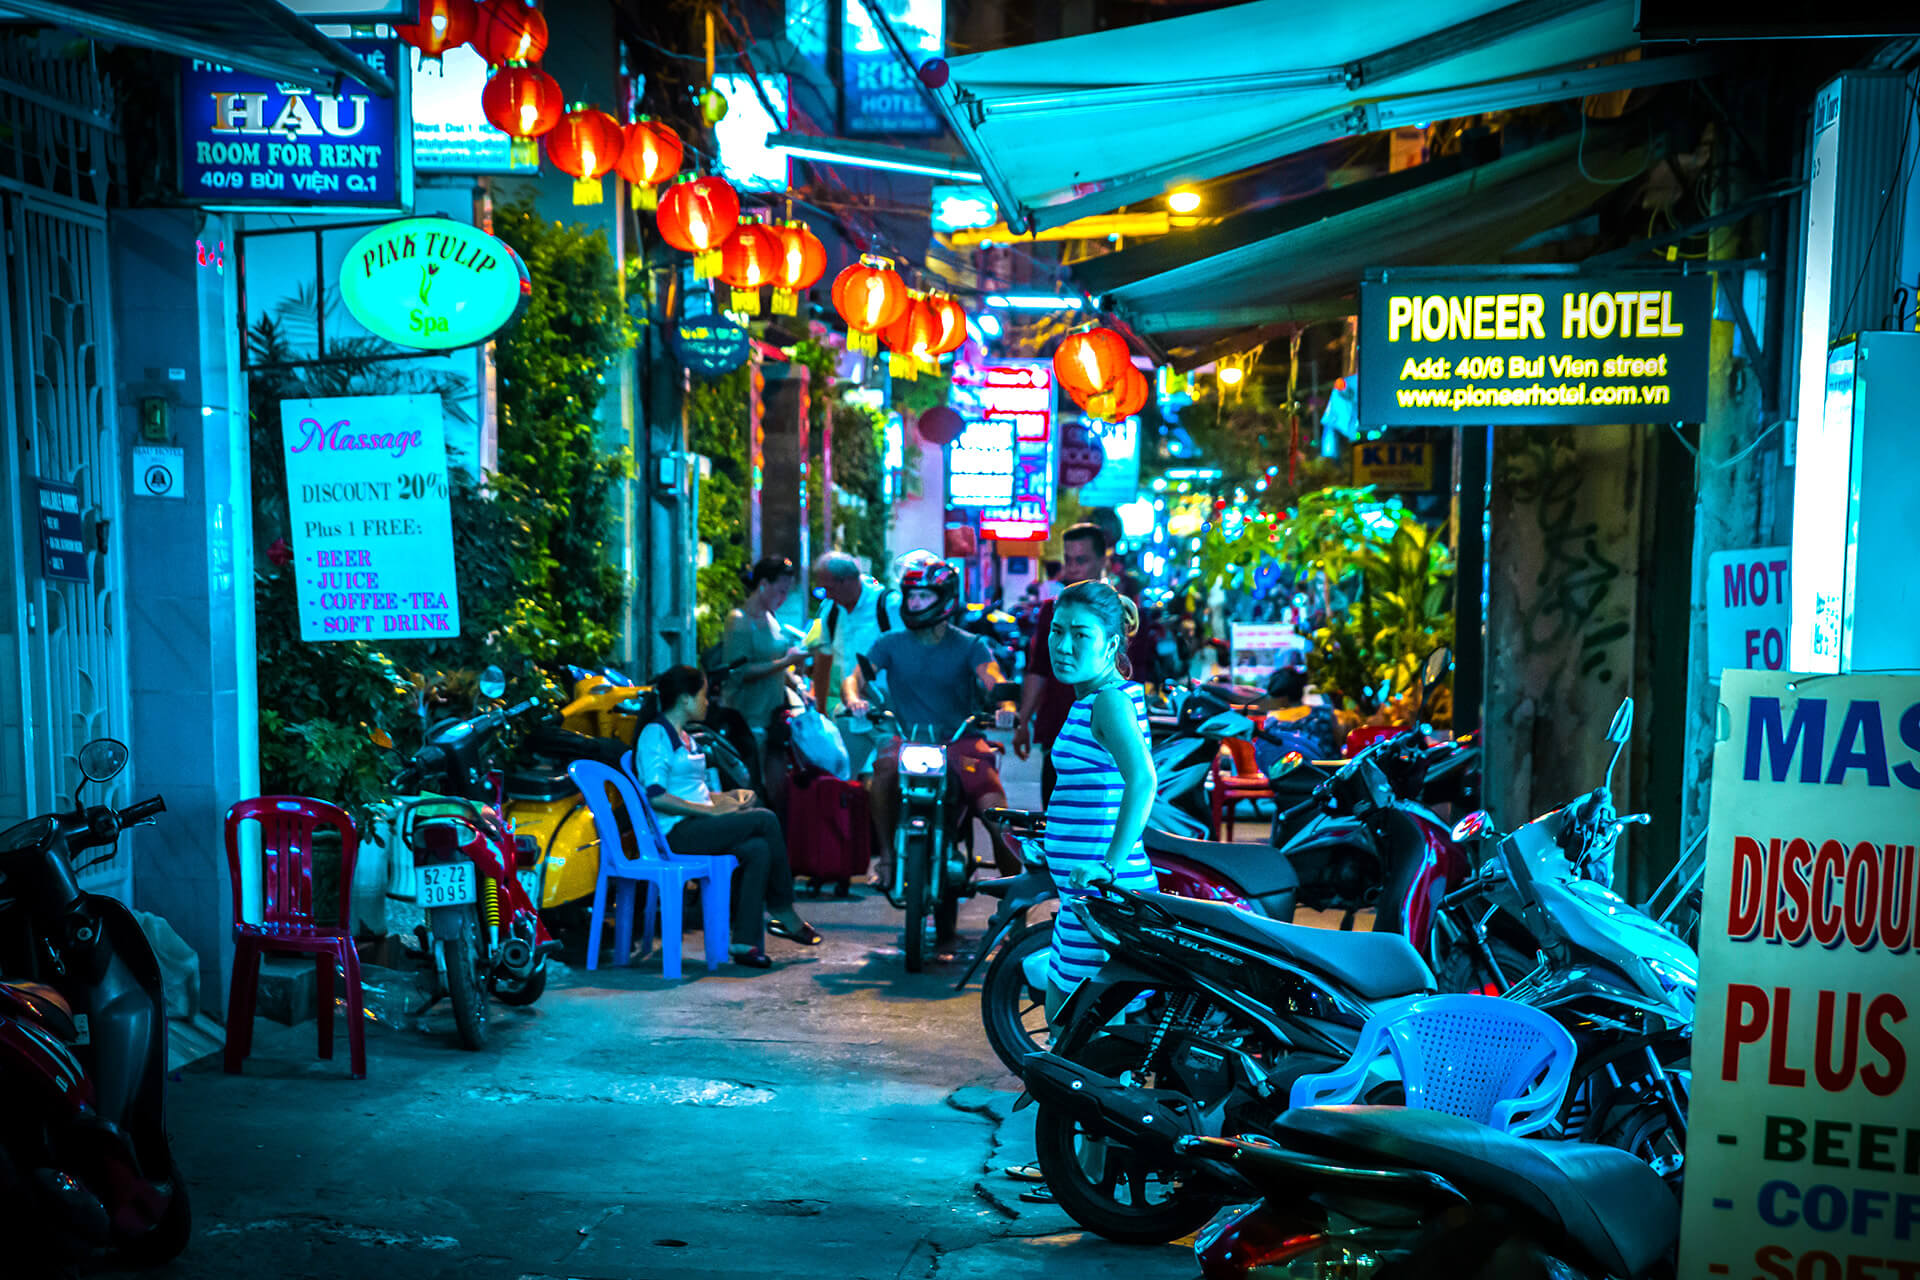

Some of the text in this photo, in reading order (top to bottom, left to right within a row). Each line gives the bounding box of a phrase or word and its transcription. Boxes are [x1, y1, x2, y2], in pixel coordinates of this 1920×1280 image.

[197, 142, 381, 168] ROOM FOR RENT
[201, 169, 377, 193] 40/9 BÙI VIỆN Q.1
[363, 232, 496, 278] PINK TULIP
[409, 308, 449, 336] Spa
[1389, 290, 1683, 342] PIONEER HOTEL
[1400, 357, 1451, 380] Add:
[1454, 356, 1504, 380] 40/6
[1602, 353, 1667, 377] street
[1396, 383, 1669, 411] www.pioneerhotel.com.vn
[291, 417, 423, 458] Massage
[1362, 446, 1423, 466] KIM
[302, 472, 447, 503] DISCOUNT 20%
[305, 518, 422, 538] Plus 1 FREE:
[317, 550, 372, 568] BEER
[317, 572, 379, 590] JUICE
[1724, 560, 1791, 608] MOT
[320, 592, 398, 610] COFFEE
[323, 613, 450, 633] SOFT DRINK
[1745, 627, 1788, 670] FO
[425, 884, 467, 904] 3095
[1728, 836, 1920, 955] DISCOU
[1721, 983, 1909, 1097] PLUS
